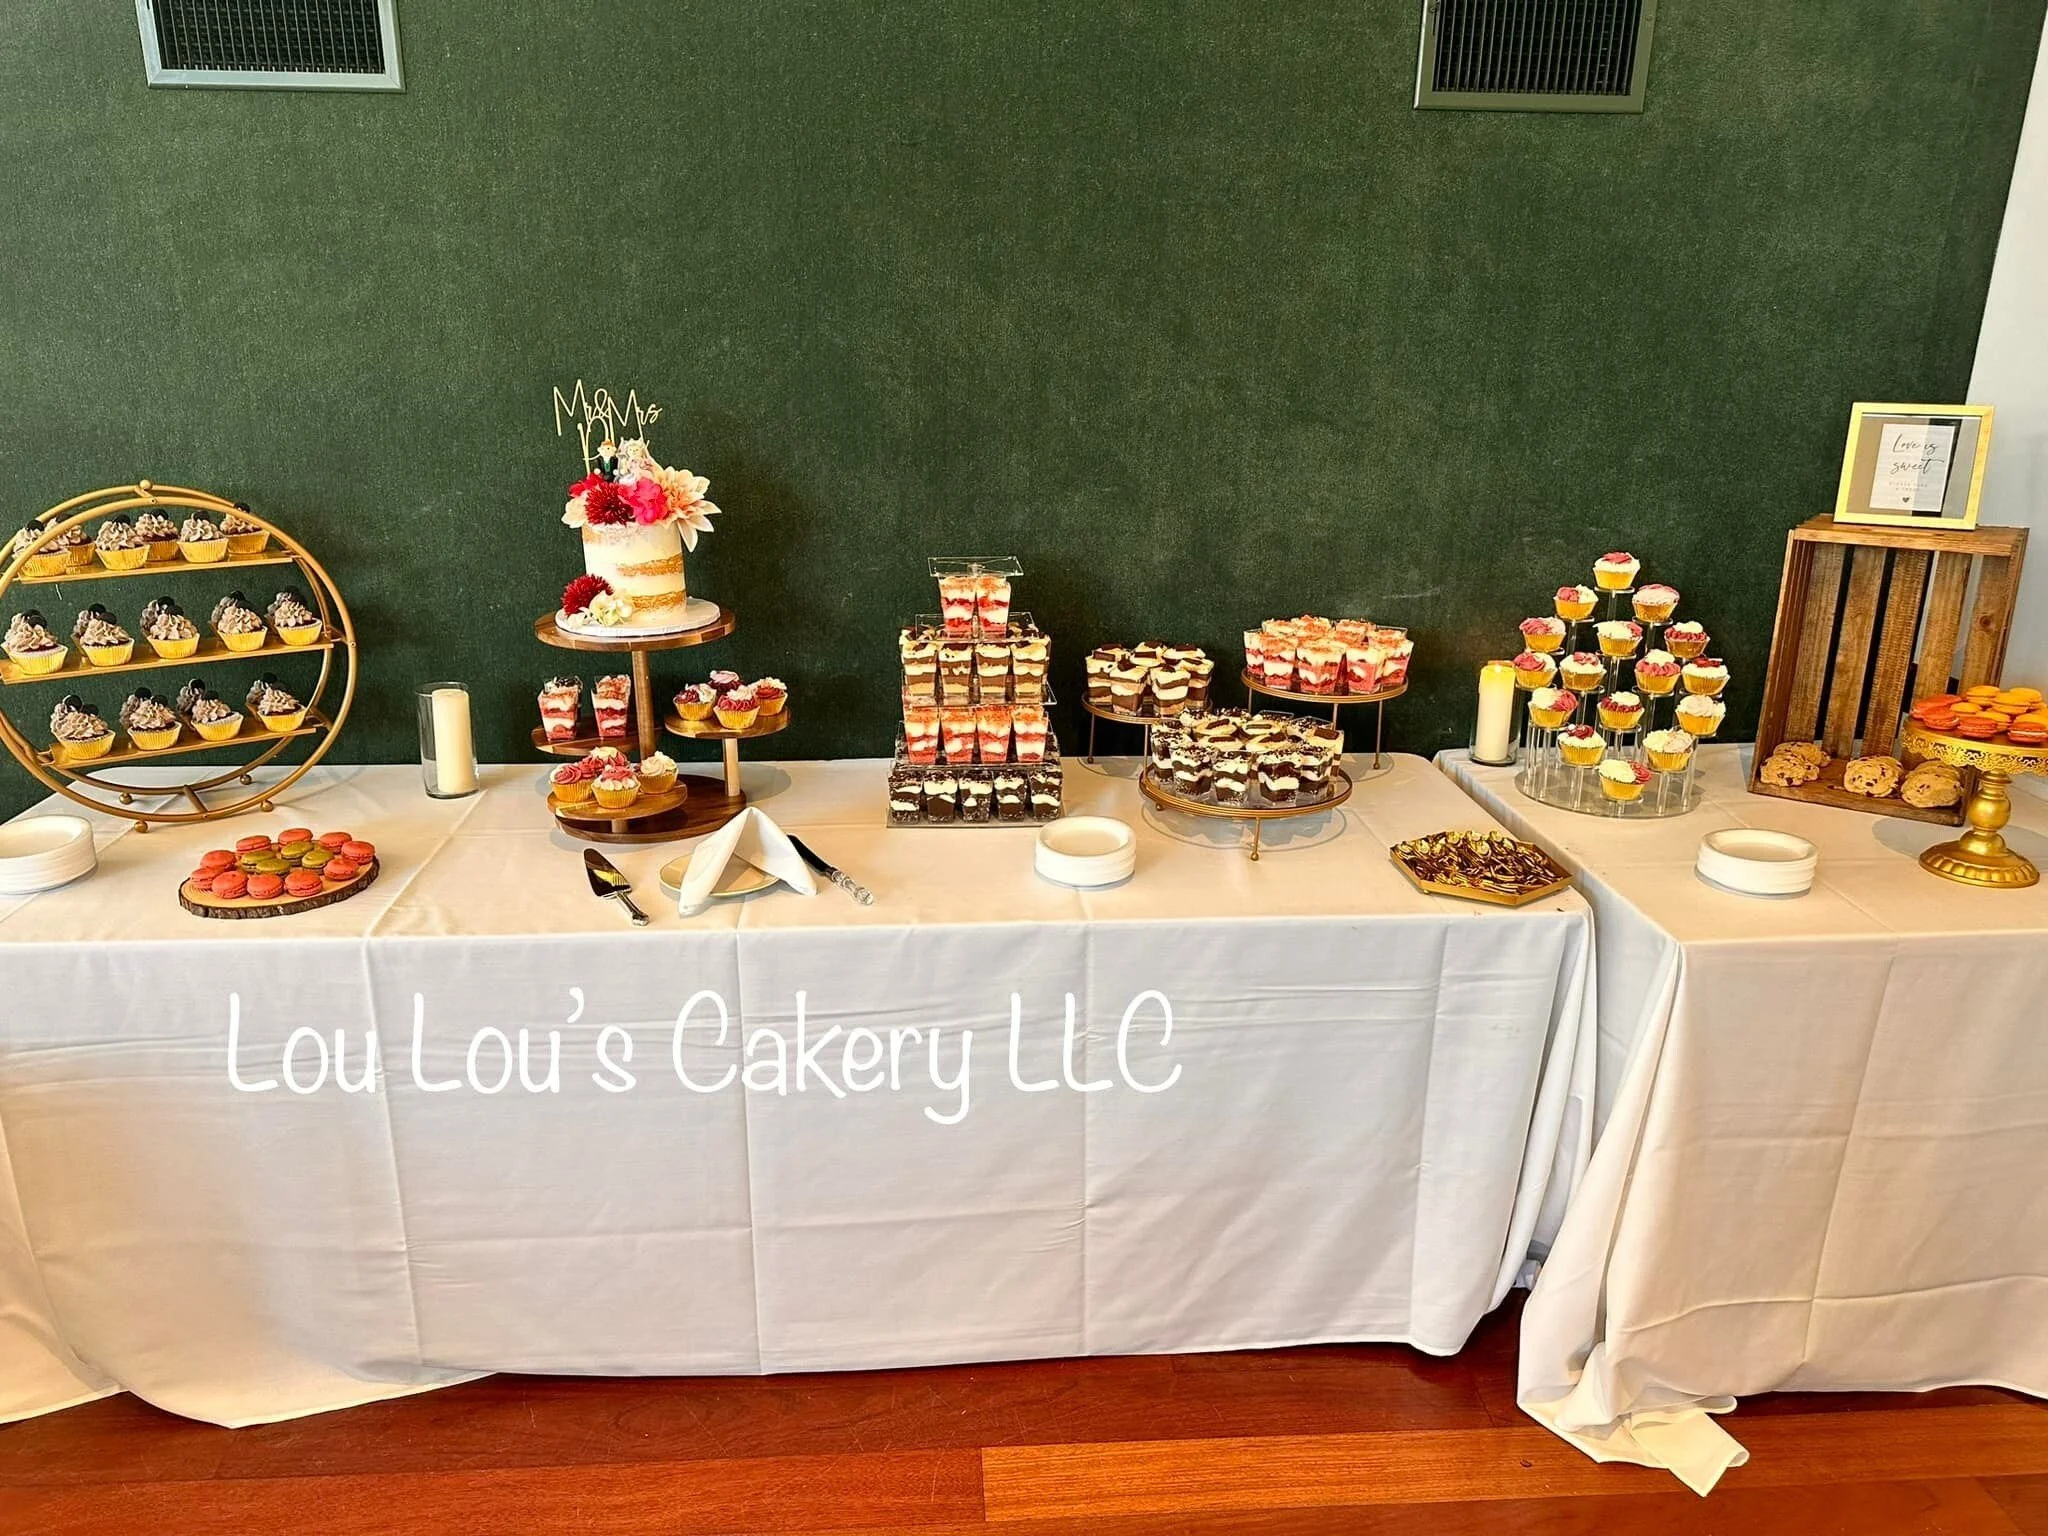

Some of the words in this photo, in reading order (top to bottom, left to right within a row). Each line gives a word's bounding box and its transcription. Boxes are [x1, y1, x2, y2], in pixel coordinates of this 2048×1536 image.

[1893, 433, 1921, 452] Love
[1923, 440, 1939, 455] is
[1890, 458, 1944, 474] sweet
